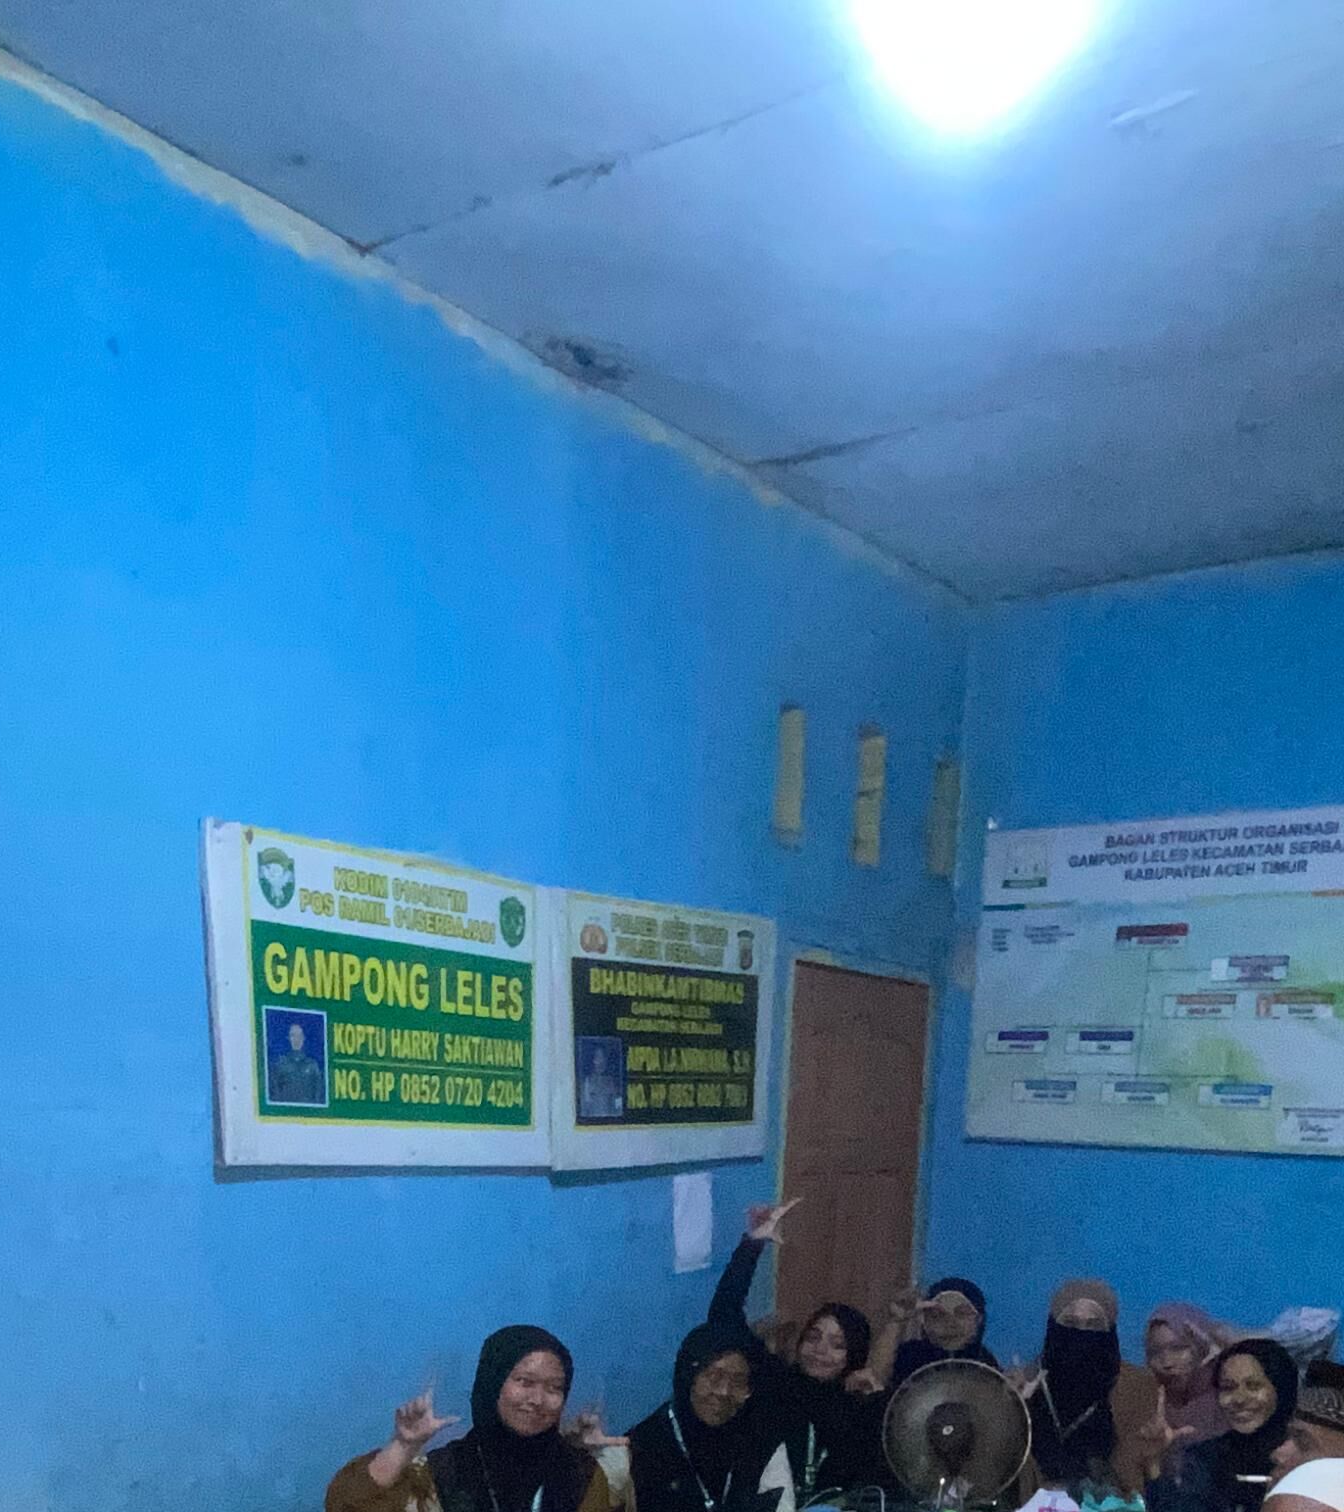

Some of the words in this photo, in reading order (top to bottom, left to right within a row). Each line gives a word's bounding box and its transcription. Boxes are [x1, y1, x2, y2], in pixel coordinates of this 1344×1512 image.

[1105, 833, 1156, 849] BAGAN
[1159, 827, 1238, 846] STRUKTUR
[1242, 821, 1340, 840] ORGANISASI
[1068, 852, 1139, 868] GAMPONG
[1142, 849, 1189, 864] LELES
[1191, 843, 1285, 861] KECAMATAN
[1124, 863, 1212, 881] KABUPATEN
[1215, 861, 1255, 876] ACEH
[1260, 859, 1308, 875] TIMUR
[299, 888, 335, 917] POS
[264, 942, 429, 1011] GAMPONG
[440, 967, 524, 1022] LELES
[333, 1022, 386, 1057] KOPTU
[391, 1028, 440, 1061] HARRY
[334, 1069, 366, 1101] NO.
[371, 1071, 395, 1102] HP
[400, 1073, 440, 1104] 0852
[445, 1076, 483, 1107] 0720
[487, 1079, 524, 1108] 4204
